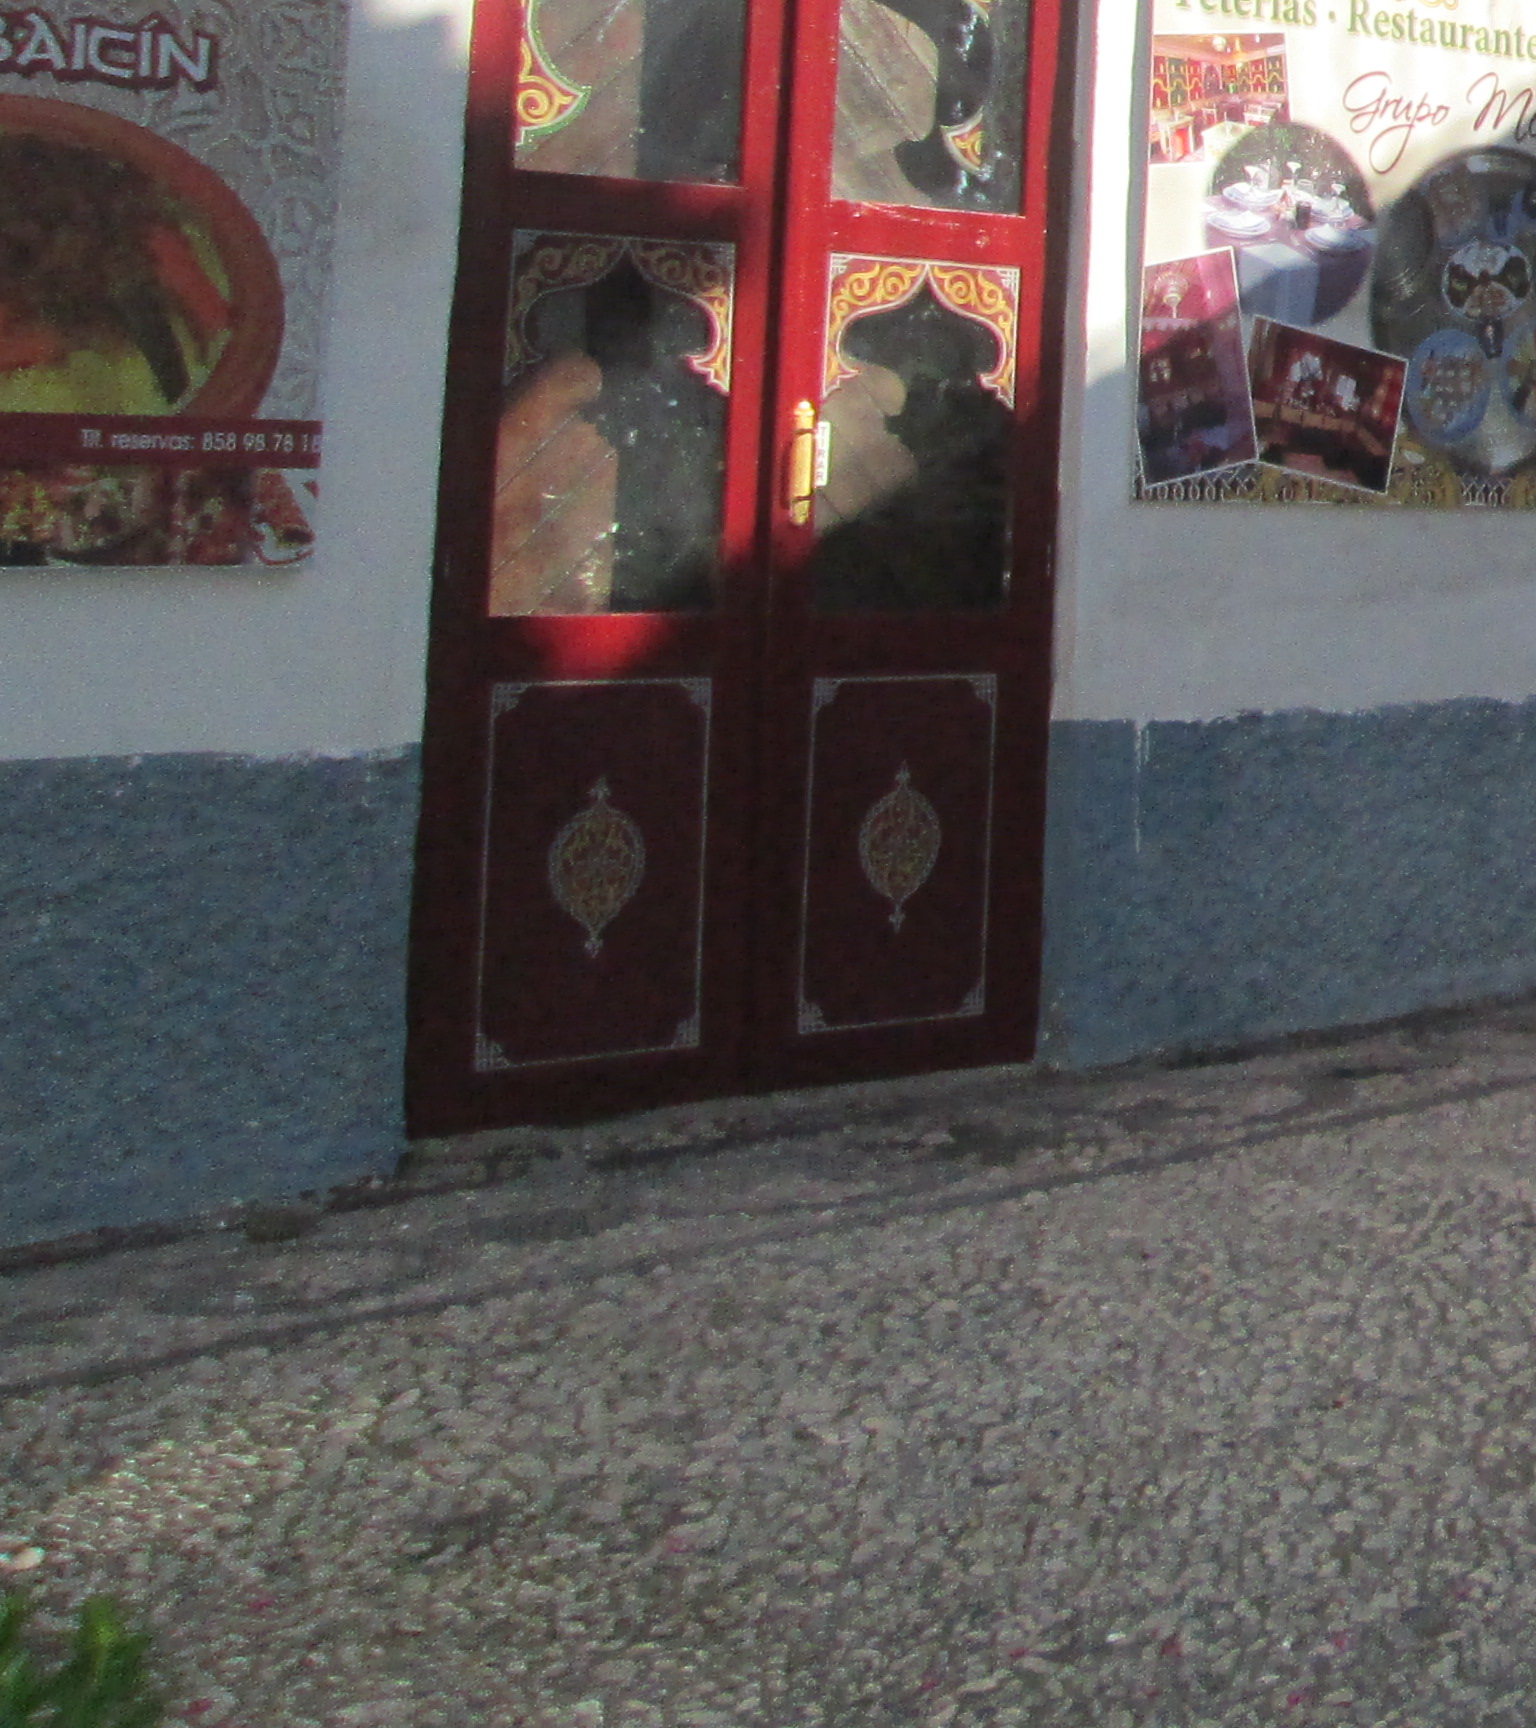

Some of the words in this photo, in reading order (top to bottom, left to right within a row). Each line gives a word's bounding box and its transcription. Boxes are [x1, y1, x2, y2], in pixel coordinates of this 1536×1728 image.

[1342, 68, 1450, 174] Grupo
[202, 431, 237, 452] 858
[272, 433, 294, 453] 78
